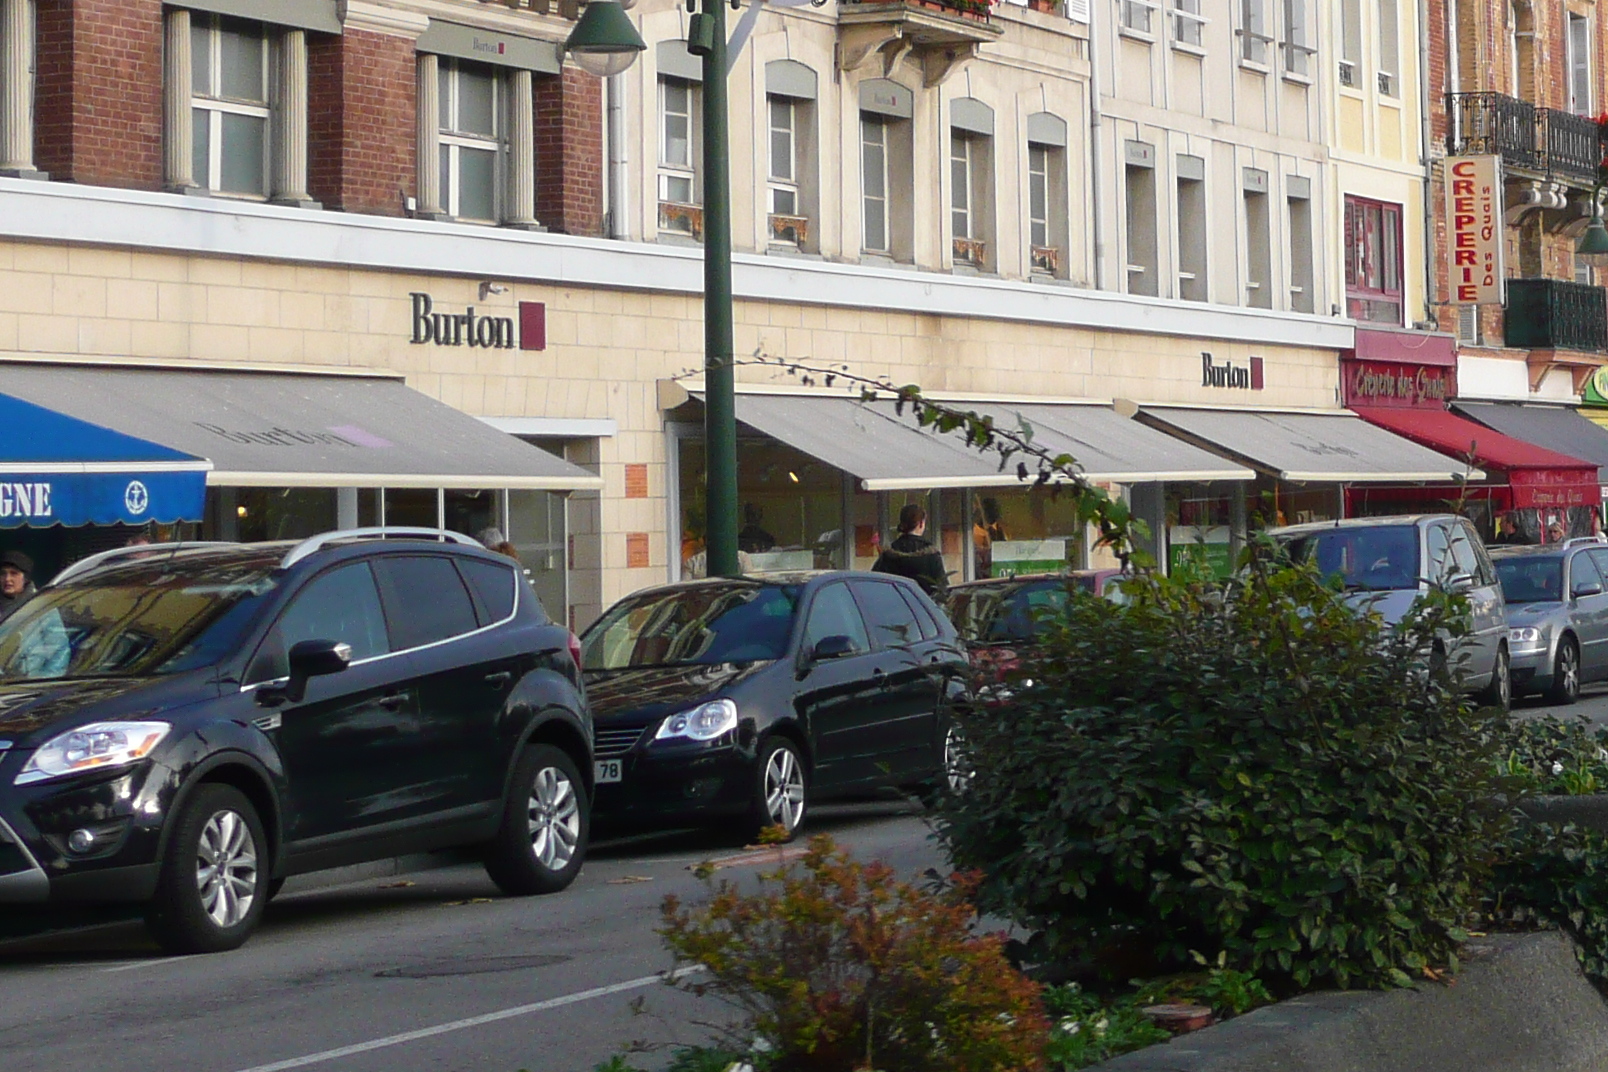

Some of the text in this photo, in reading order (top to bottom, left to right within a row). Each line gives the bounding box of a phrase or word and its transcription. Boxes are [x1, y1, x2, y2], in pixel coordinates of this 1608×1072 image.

[1452, 161, 1477, 302] CREPERIE
[1481, 185, 1493, 287] Des Quais
[408, 292, 516, 350] Burton
[1201, 352, 1250, 389] Burton
[0, 483, 52, 517] GNE
[600, 763, 618, 779] 78
